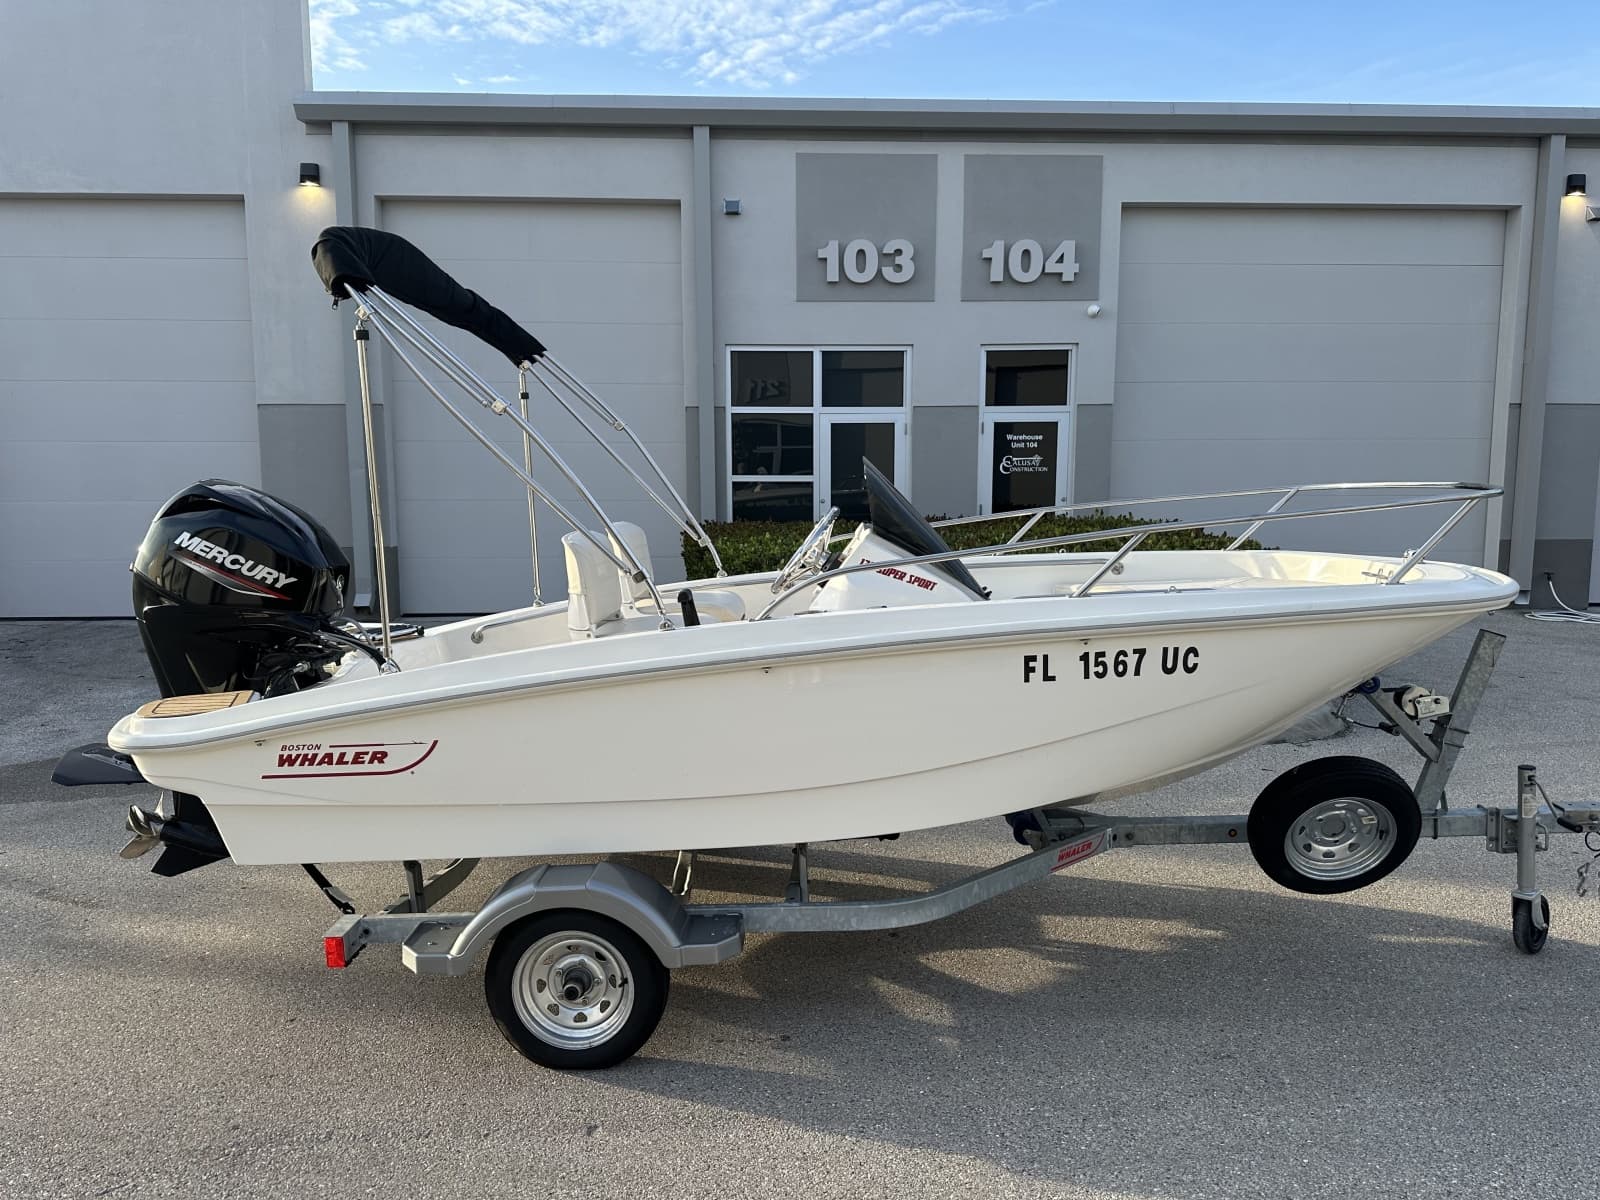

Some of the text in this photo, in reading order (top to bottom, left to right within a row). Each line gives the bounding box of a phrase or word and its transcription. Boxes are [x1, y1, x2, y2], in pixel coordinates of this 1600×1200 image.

[818, 239, 915, 283] 103
[982, 239, 1080, 283] 104
[1006, 433, 1043, 441] Warehouse
[1000, 461, 1048, 475] CONSTRUCTION
[174, 531, 298, 589] MERCURY
[906, 574, 938, 591] SPORT
[1023, 646, 1200, 683] FL 1567 UC
[281, 743, 322, 752] BOSTON
[277, 750, 388, 768] WHALER
[1057, 841, 1093, 862] WHALER
